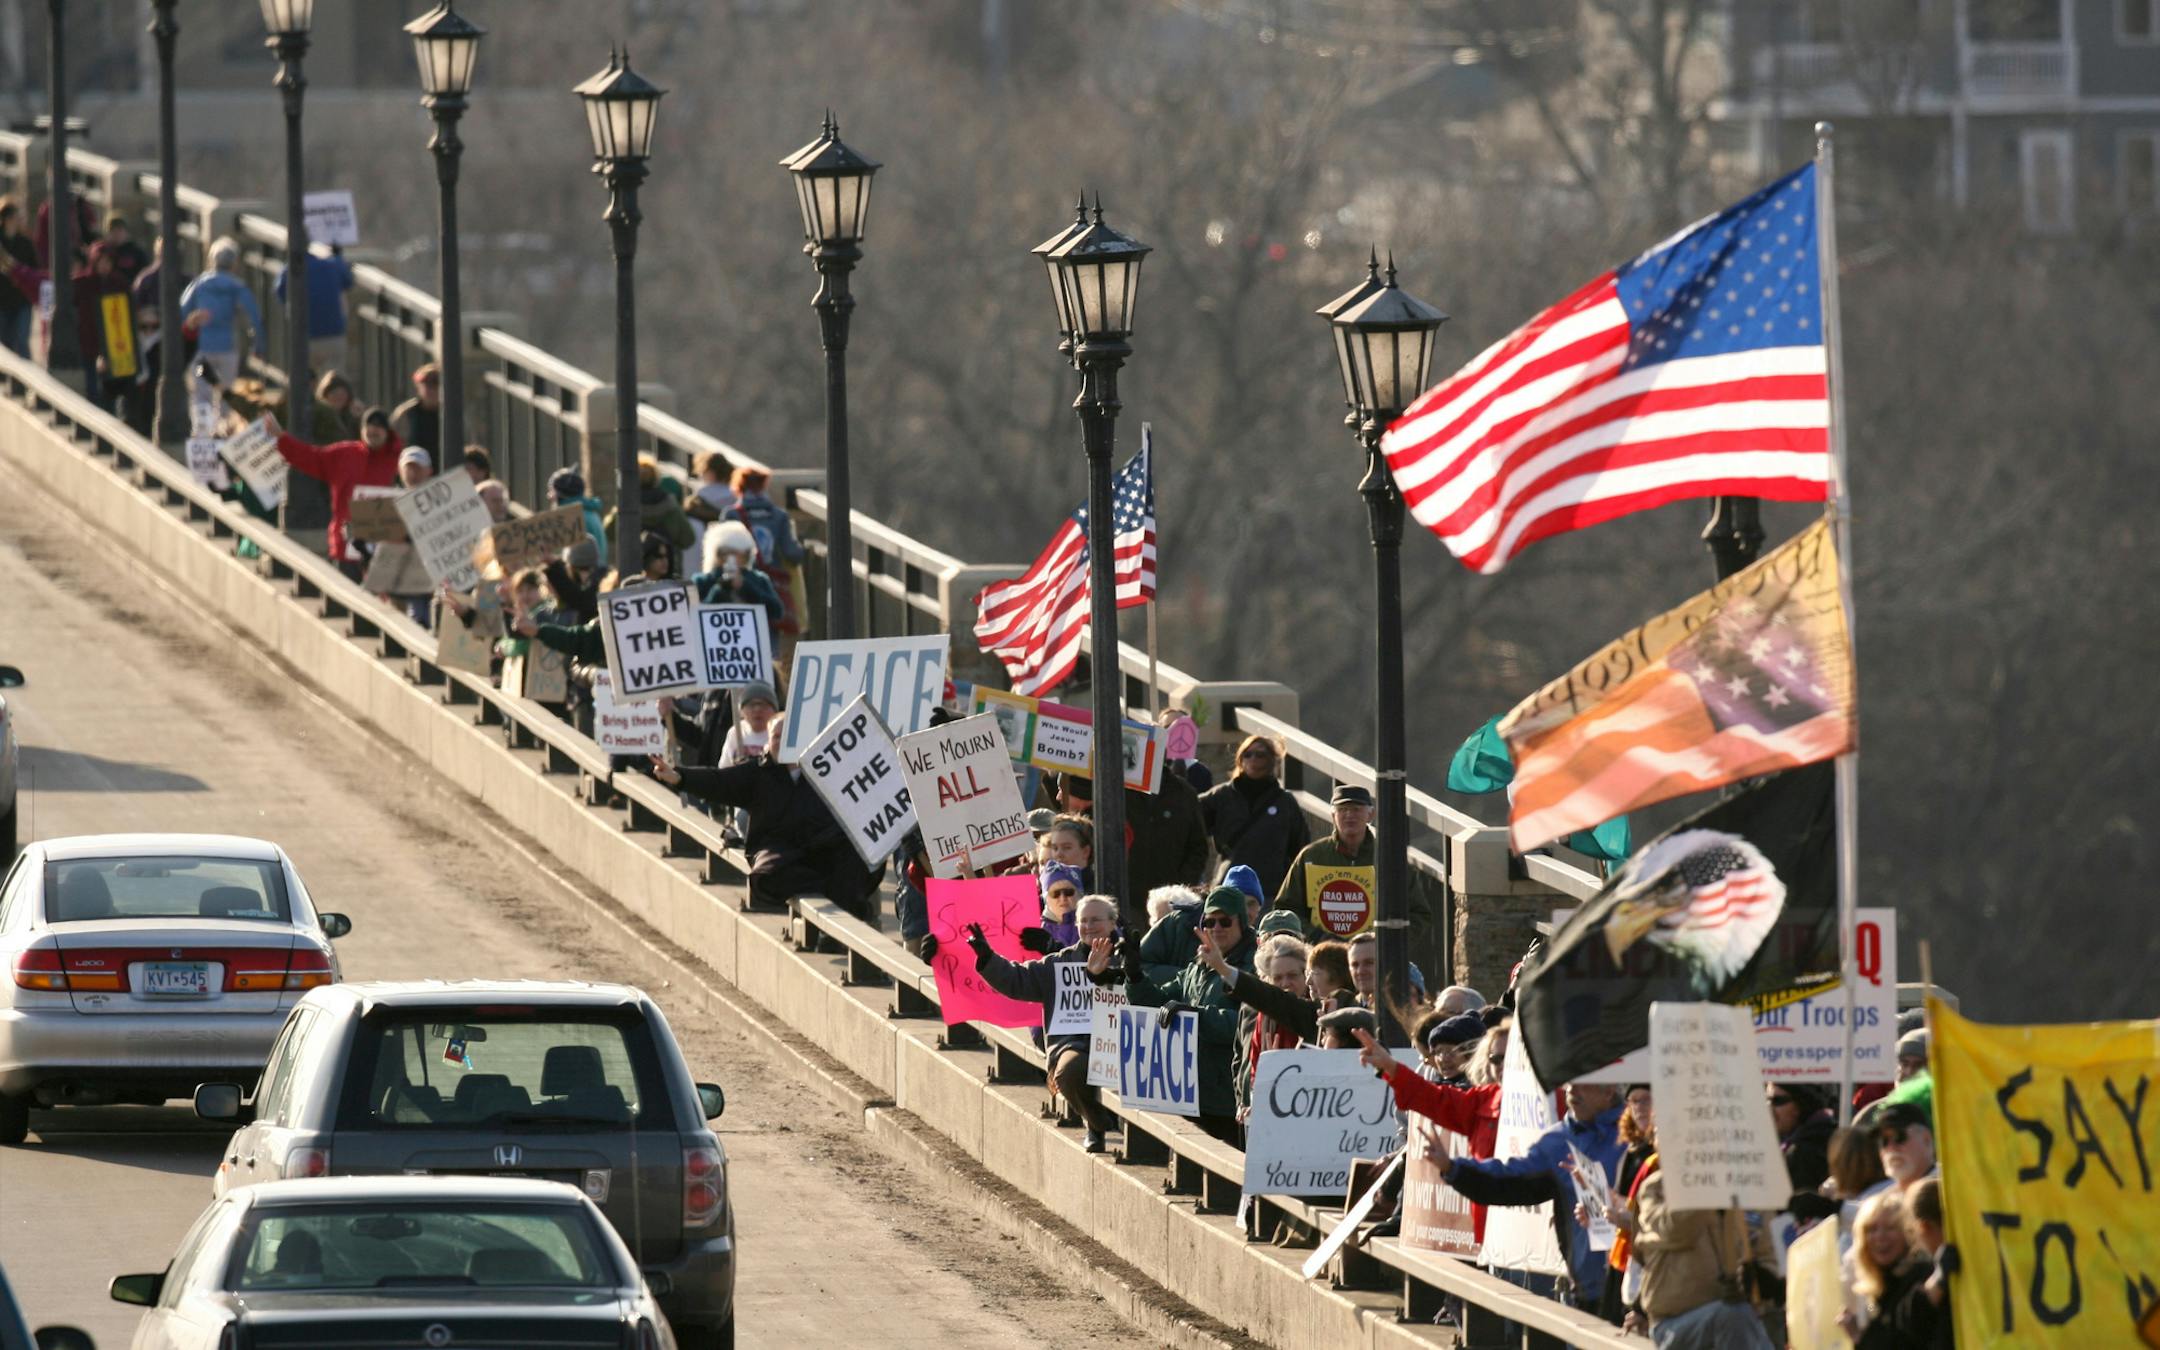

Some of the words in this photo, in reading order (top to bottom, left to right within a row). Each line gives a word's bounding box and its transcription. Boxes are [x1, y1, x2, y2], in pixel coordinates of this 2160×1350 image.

[414, 481, 452, 515] END
[613, 591, 686, 622] STOP
[709, 612, 746, 628] OUT
[626, 626, 686, 653] THE
[718, 630, 741, 645] OF
[709, 647, 755, 663] IRAQ
[629, 659, 695, 688] WAR
[711, 664, 757, 681] NOW
[786, 649, 942, 748] PEACE
[602, 714, 628, 728] Bring
[631, 714, 658, 726] them
[1041, 720, 1059, 731] Who
[1061, 726, 1089, 737] Would
[615, 735, 648, 746] Home!
[811, 713, 867, 777] STOP
[1050, 734, 1076, 744] Jesus
[1037, 743, 1085, 761] Bomb?
[841, 752, 891, 803] THE
[937, 765, 990, 808] ALL
[862, 787, 912, 843] WAR
[966, 813, 1025, 847] DEATHS
[1322, 891, 1343, 901] IRAQ
[1344, 892, 1365, 902] WAR
[1326, 911, 1359, 922] WRONG
[1333, 922, 1352, 932] WAY
[1060, 989, 1093, 1011] NOW
[1094, 987, 1127, 1009] Suppo
[1095, 1038, 1116, 1053] Brin
[1120, 1009, 1195, 1103] PEACE
[1758, 1045, 1881, 1062] ngressperon!
[1269, 1064, 1355, 1119] Come
[1996, 1063, 2153, 1193] SAY
[1338, 1129, 1369, 1153] We
[1266, 1160, 1300, 1188] You
[1429, 1226, 1475, 1250] congresspeop
[1981, 1210, 2082, 1334] TO
